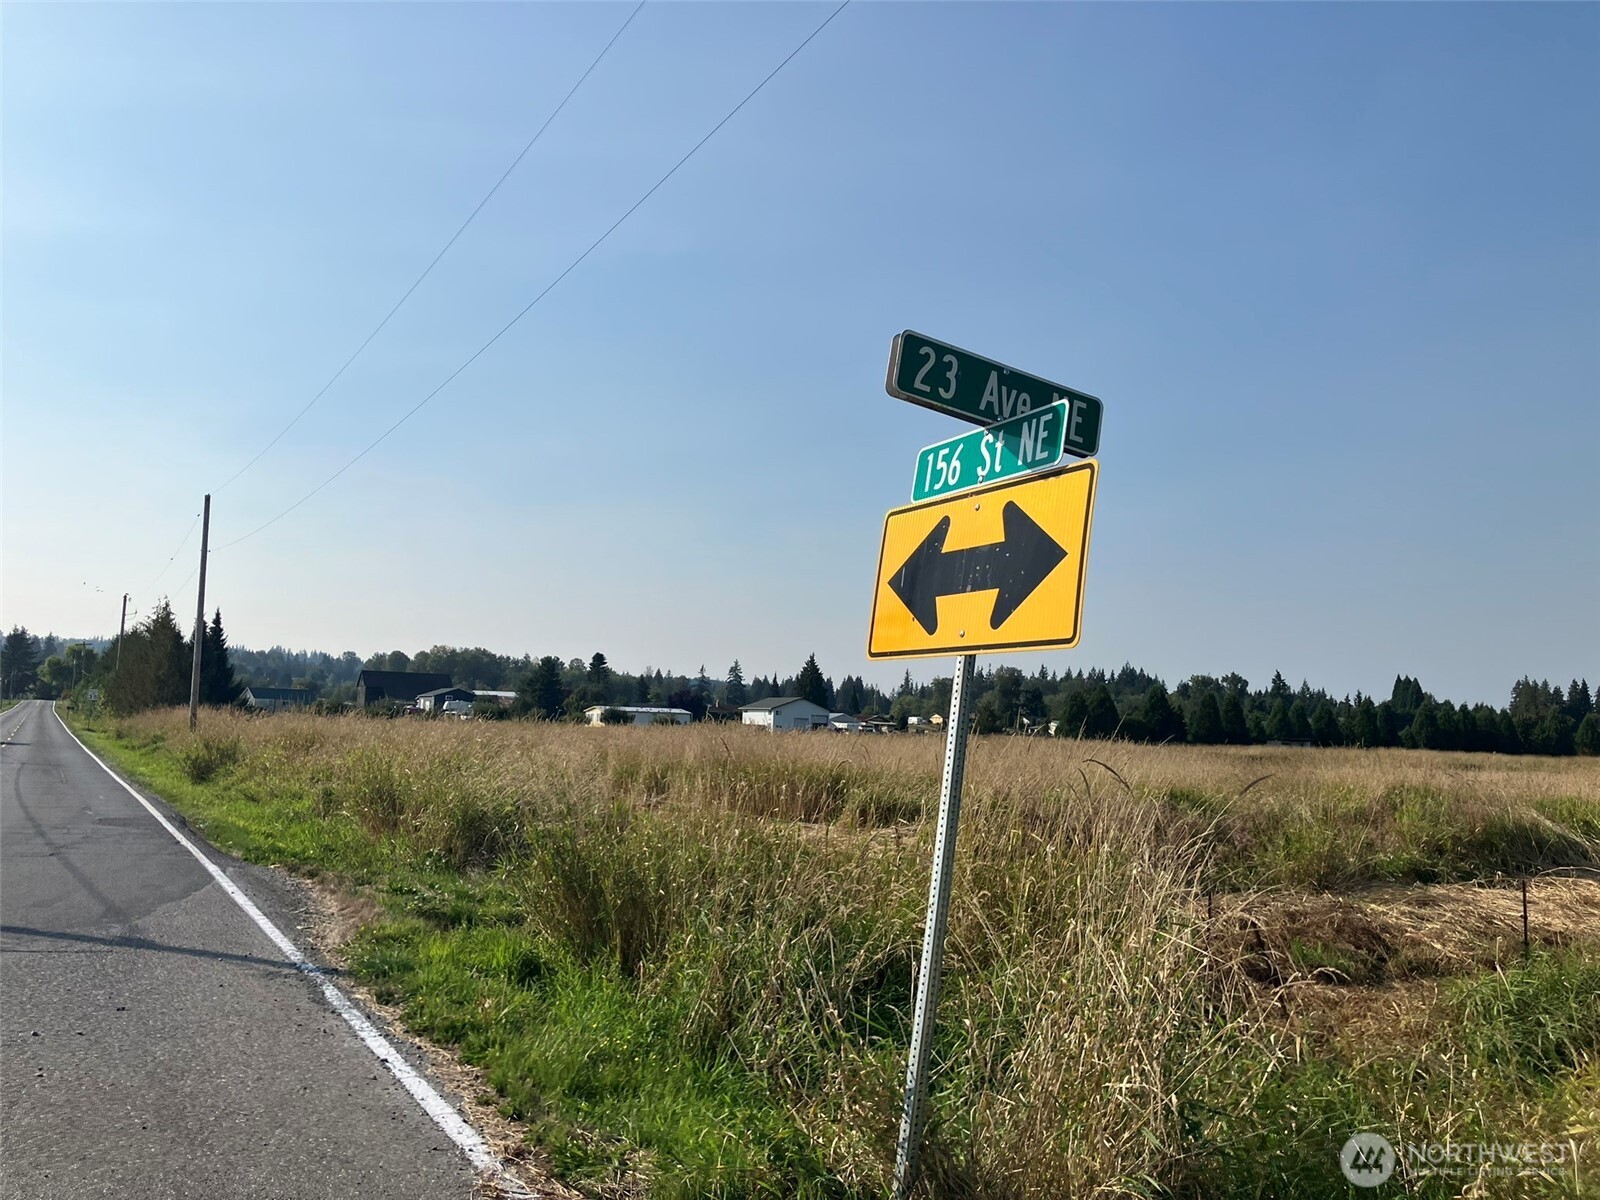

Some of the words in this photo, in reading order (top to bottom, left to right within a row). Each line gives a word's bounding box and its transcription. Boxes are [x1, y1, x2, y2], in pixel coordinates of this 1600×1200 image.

[913, 346, 959, 399] 23
[978, 370, 1031, 418] Ave
[1052, 392, 1088, 443] E
[924, 443, 964, 492] 156
[976, 429, 1005, 477] St
[1017, 413, 1054, 466] NE
